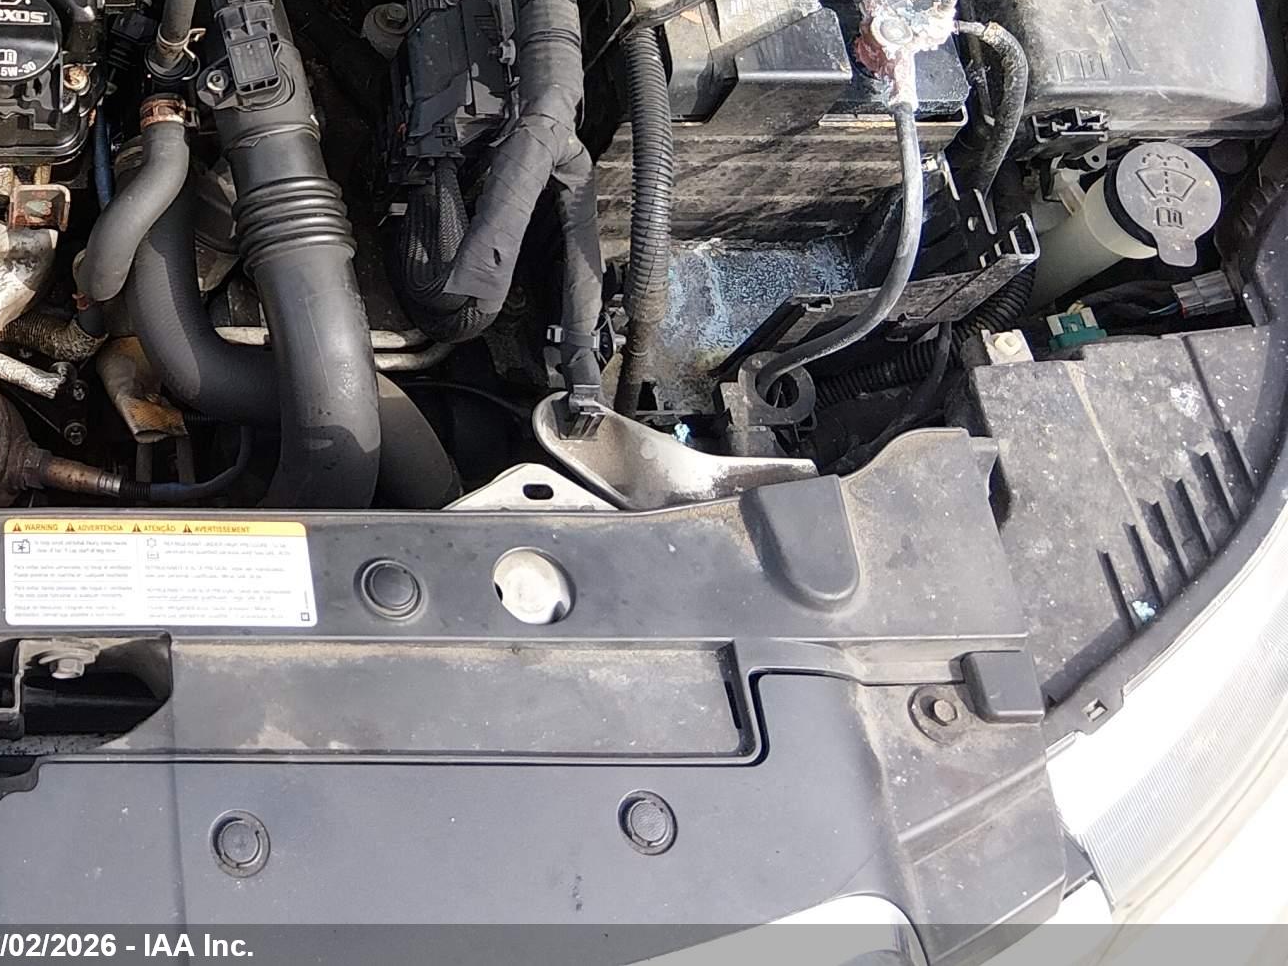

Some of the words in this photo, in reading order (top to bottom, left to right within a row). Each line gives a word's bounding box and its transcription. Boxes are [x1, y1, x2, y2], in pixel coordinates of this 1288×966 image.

[0, 61, 37, 77] 5W-30
[24, 523, 59, 531] WARNING
[77, 524, 124, 532] ADVERTENCIA
[194, 525, 250, 534] AVERTISSEMENT
